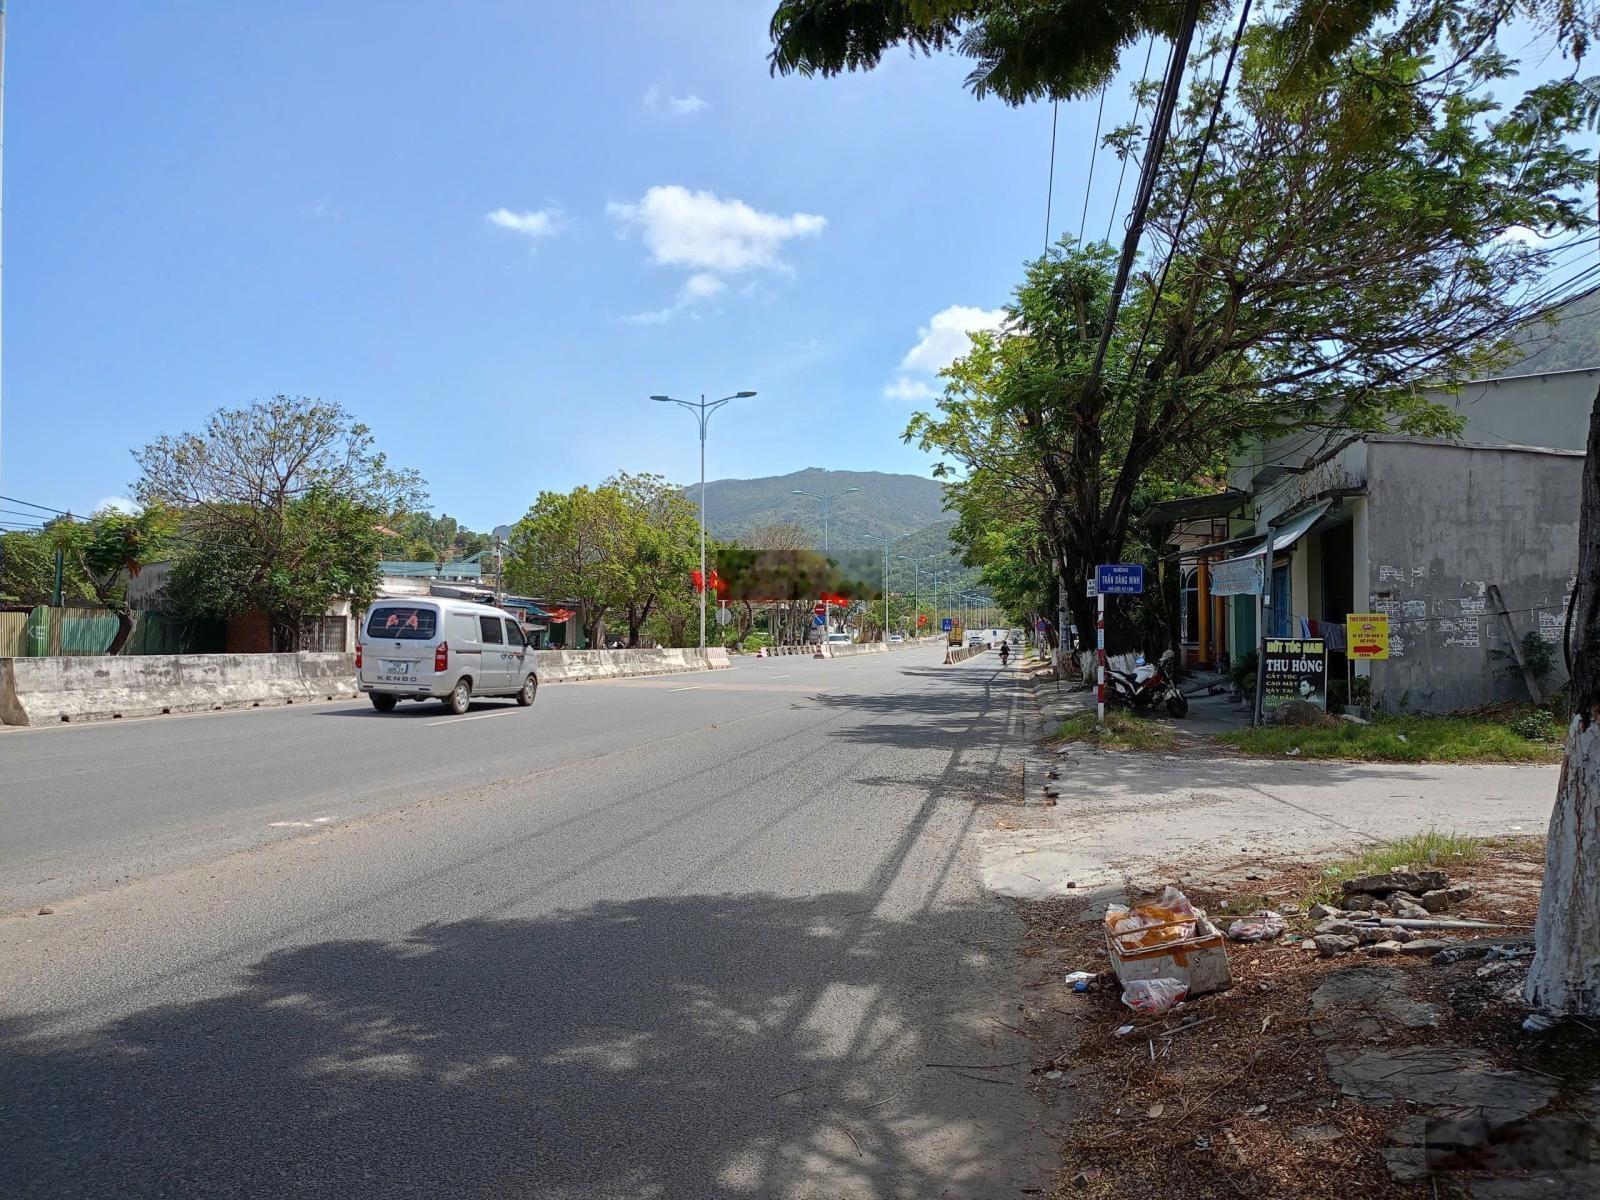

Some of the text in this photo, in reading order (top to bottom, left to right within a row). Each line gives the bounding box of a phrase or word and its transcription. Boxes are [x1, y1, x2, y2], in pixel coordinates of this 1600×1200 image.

[1285, 640, 1301, 653] TÓC
[1303, 642, 1324, 654] NAM
[1266, 659, 1289, 672] THU
